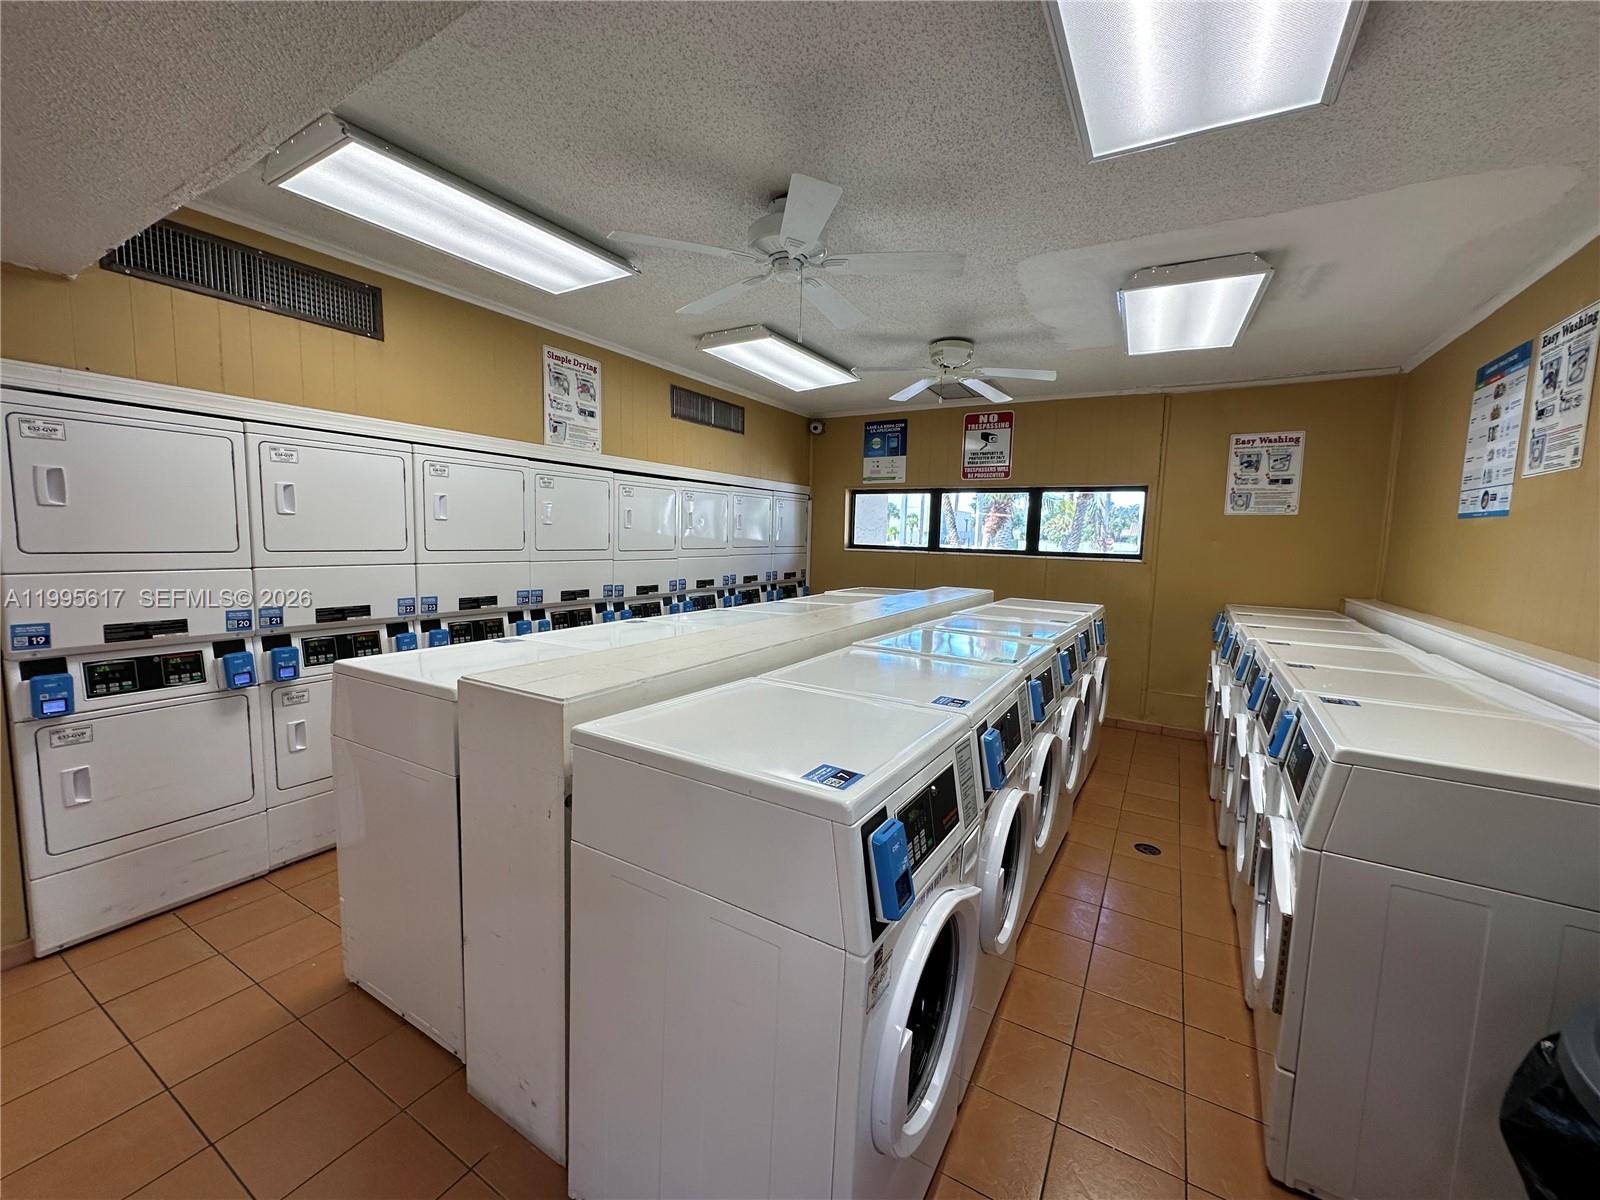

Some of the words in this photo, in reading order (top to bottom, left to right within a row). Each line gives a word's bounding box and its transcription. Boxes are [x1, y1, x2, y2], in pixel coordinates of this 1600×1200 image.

[1542, 331, 1560, 348] Easy
[1562, 311, 1599, 337] Washing
[547, 351, 572, 365] Simple
[573, 359, 598, 374] Drying
[979, 414, 999, 424] NO
[968, 422, 1010, 430] TRESPASSING
[1234, 438, 1256, 446] Easy
[1259, 436, 1301, 444] Washing
[238, 620, 251, 628] 20
[31, 636, 46, 645] 19
